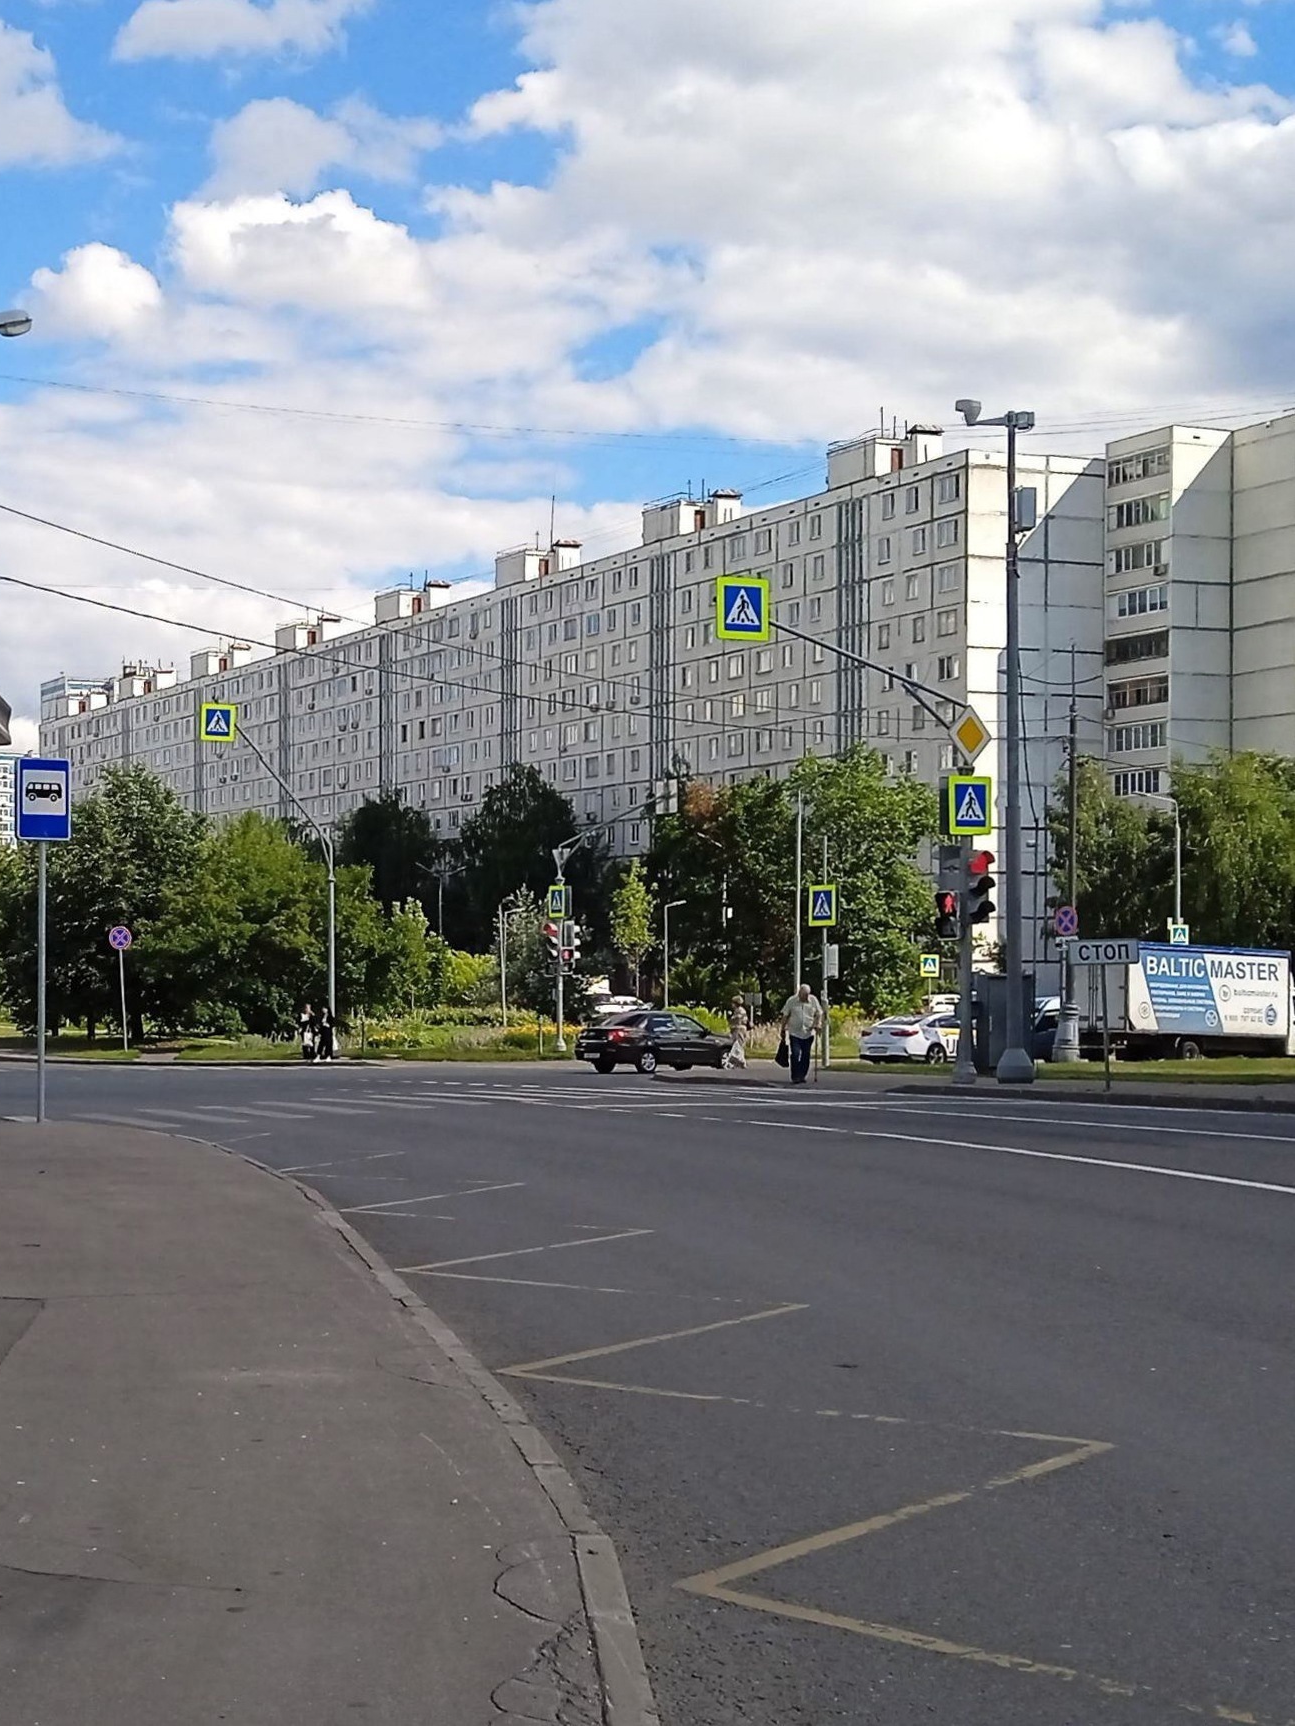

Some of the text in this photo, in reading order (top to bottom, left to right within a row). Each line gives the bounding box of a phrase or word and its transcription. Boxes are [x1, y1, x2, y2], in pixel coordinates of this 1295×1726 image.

[1078, 944, 1130, 961] СТОП
[1146, 956, 1279, 981] BALTIC MASTER
